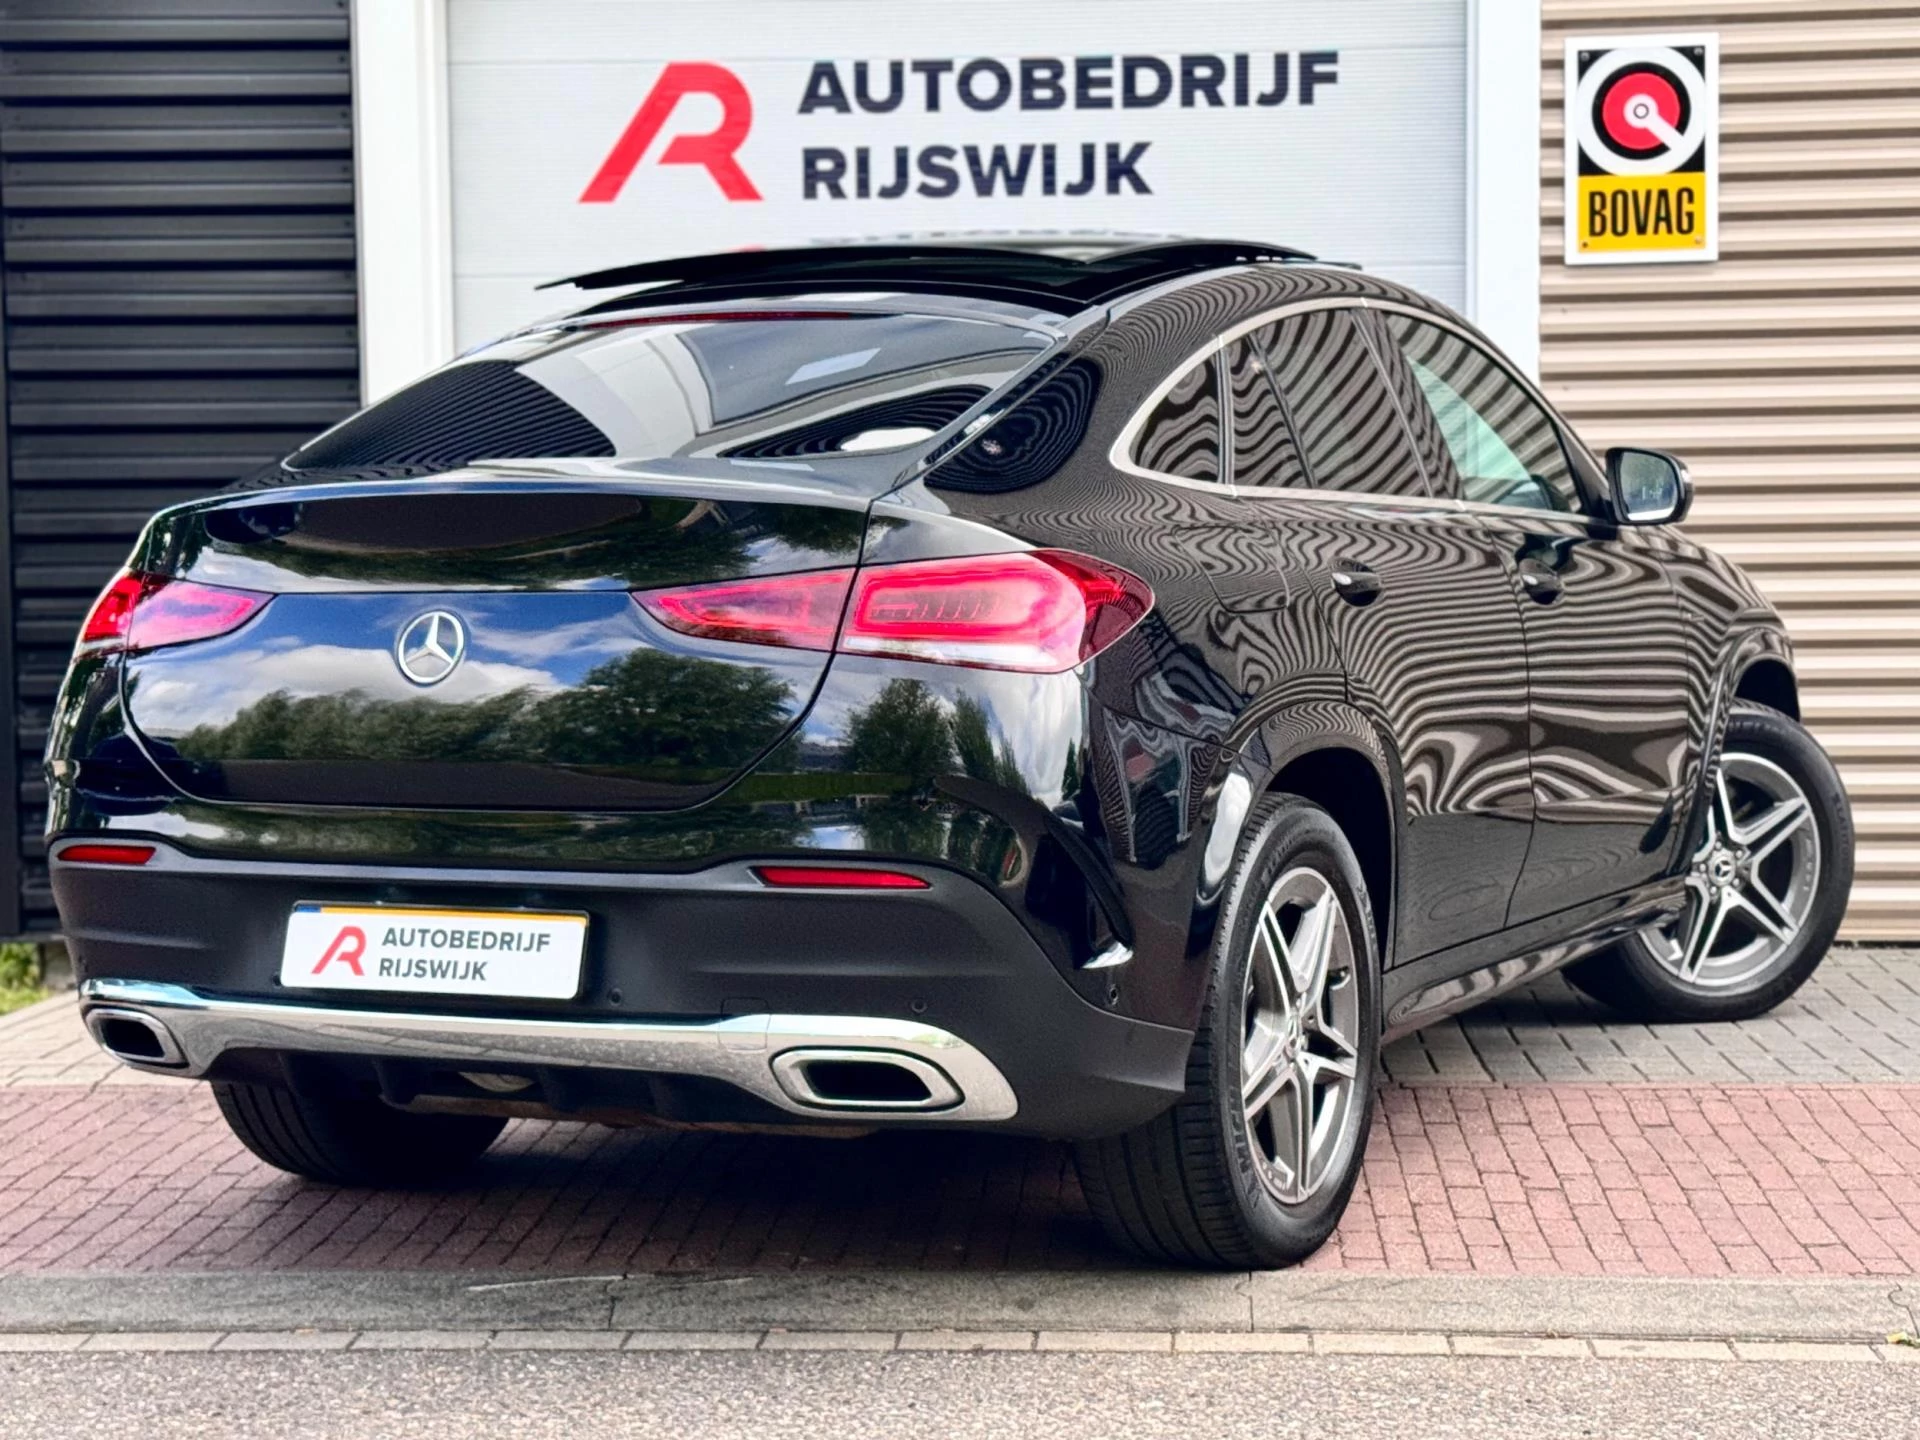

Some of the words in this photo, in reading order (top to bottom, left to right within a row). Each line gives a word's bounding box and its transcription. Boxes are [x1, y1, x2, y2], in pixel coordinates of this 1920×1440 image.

[798, 51, 1339, 115] AUTOBEDRIJF
[801, 141, 1153, 200] RIJSWIJK
[1588, 187, 1695, 237] BOVAG
[381, 927, 551, 953] AUTOBEDRIJF
[378, 957, 488, 981] RIJSWIJK
